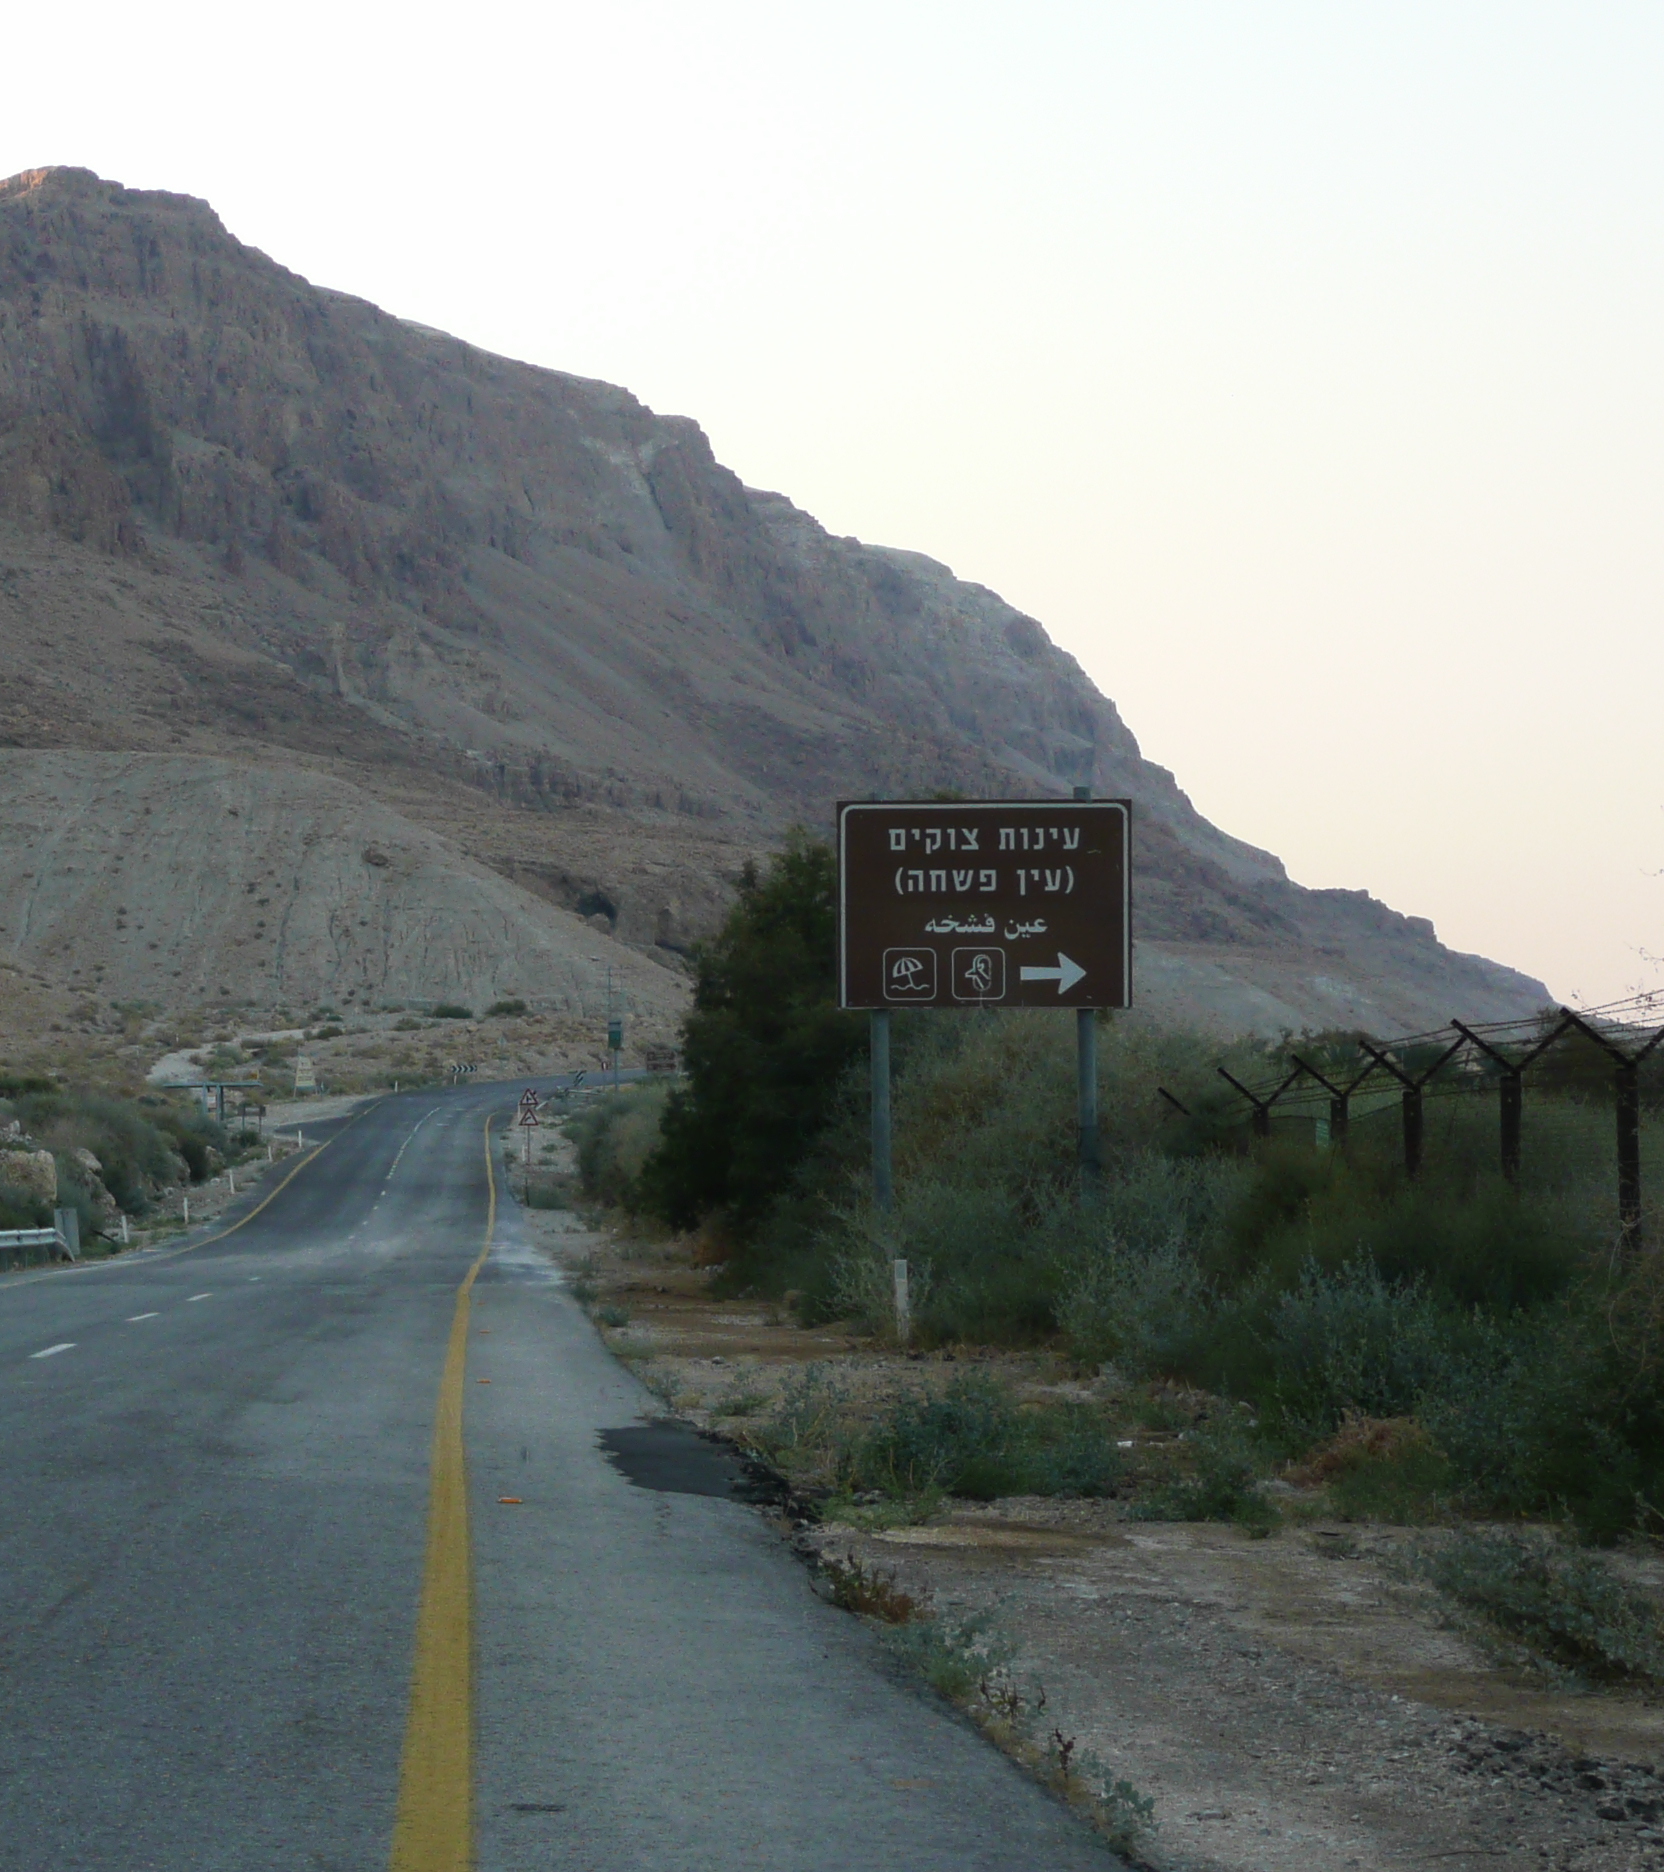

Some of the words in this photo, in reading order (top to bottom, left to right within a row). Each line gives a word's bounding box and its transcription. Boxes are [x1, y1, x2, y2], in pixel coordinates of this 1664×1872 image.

[888, 827, 979, 854] צוקים
[998, 827, 1080, 851] עינות
[895, 866, 998, 896] פשחה)
[1016, 865, 1075, 896] (עין
[1004, 917, 1048, 940] عين
